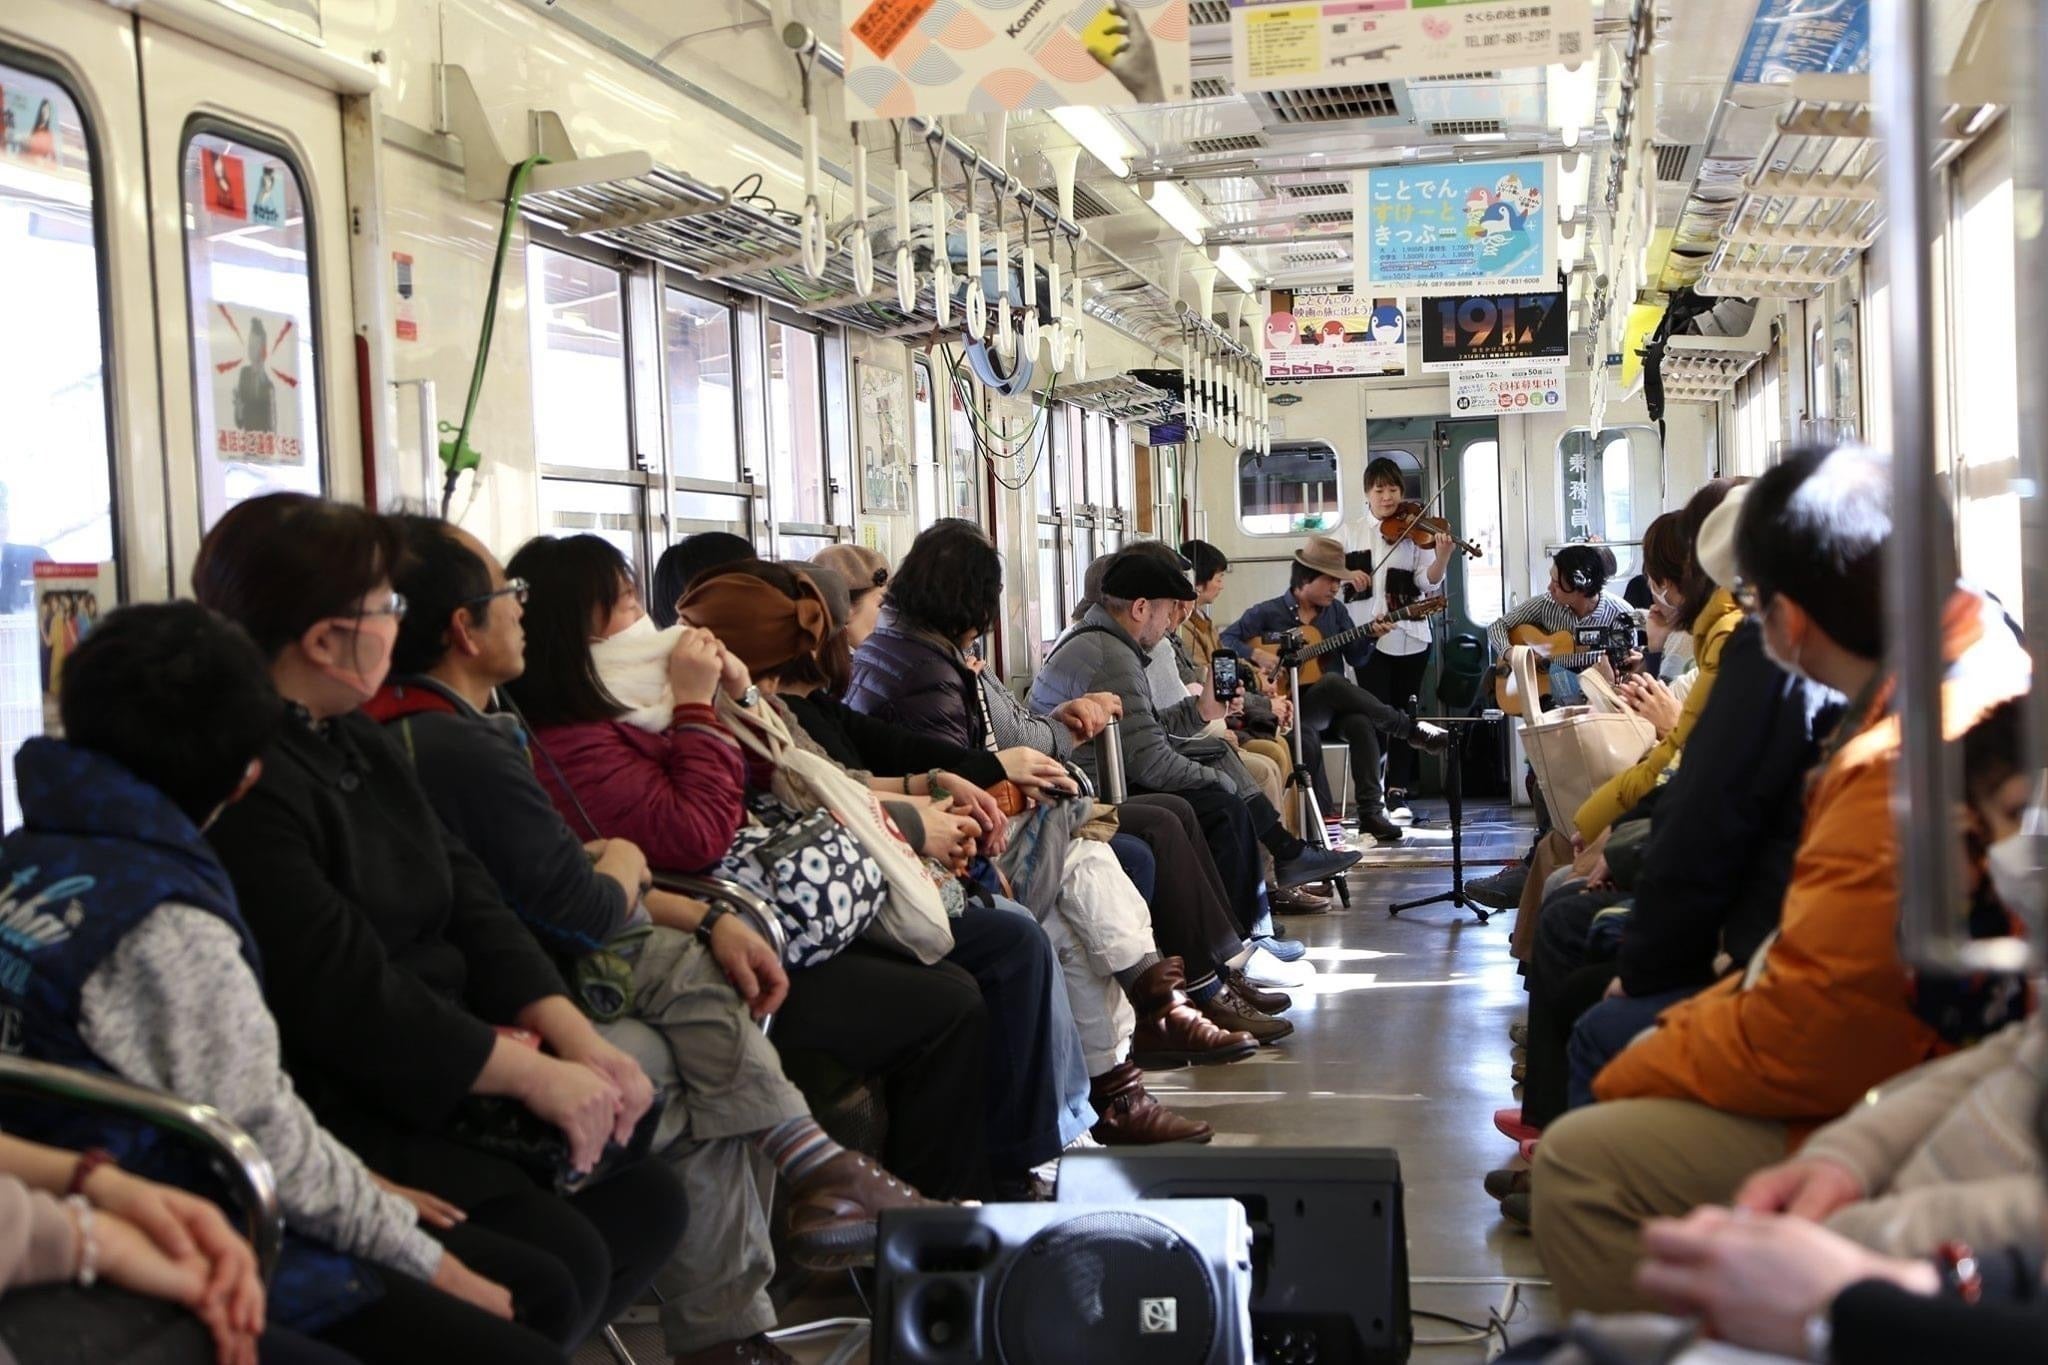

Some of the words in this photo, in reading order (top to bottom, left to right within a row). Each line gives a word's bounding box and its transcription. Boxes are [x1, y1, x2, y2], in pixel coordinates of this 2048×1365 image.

[1374, 179, 1458, 201] ことでん
[1374, 201, 1456, 223] すけーと
[1375, 224, 1437, 246] きっぷ
[1438, 295, 1558, 348] 1917
